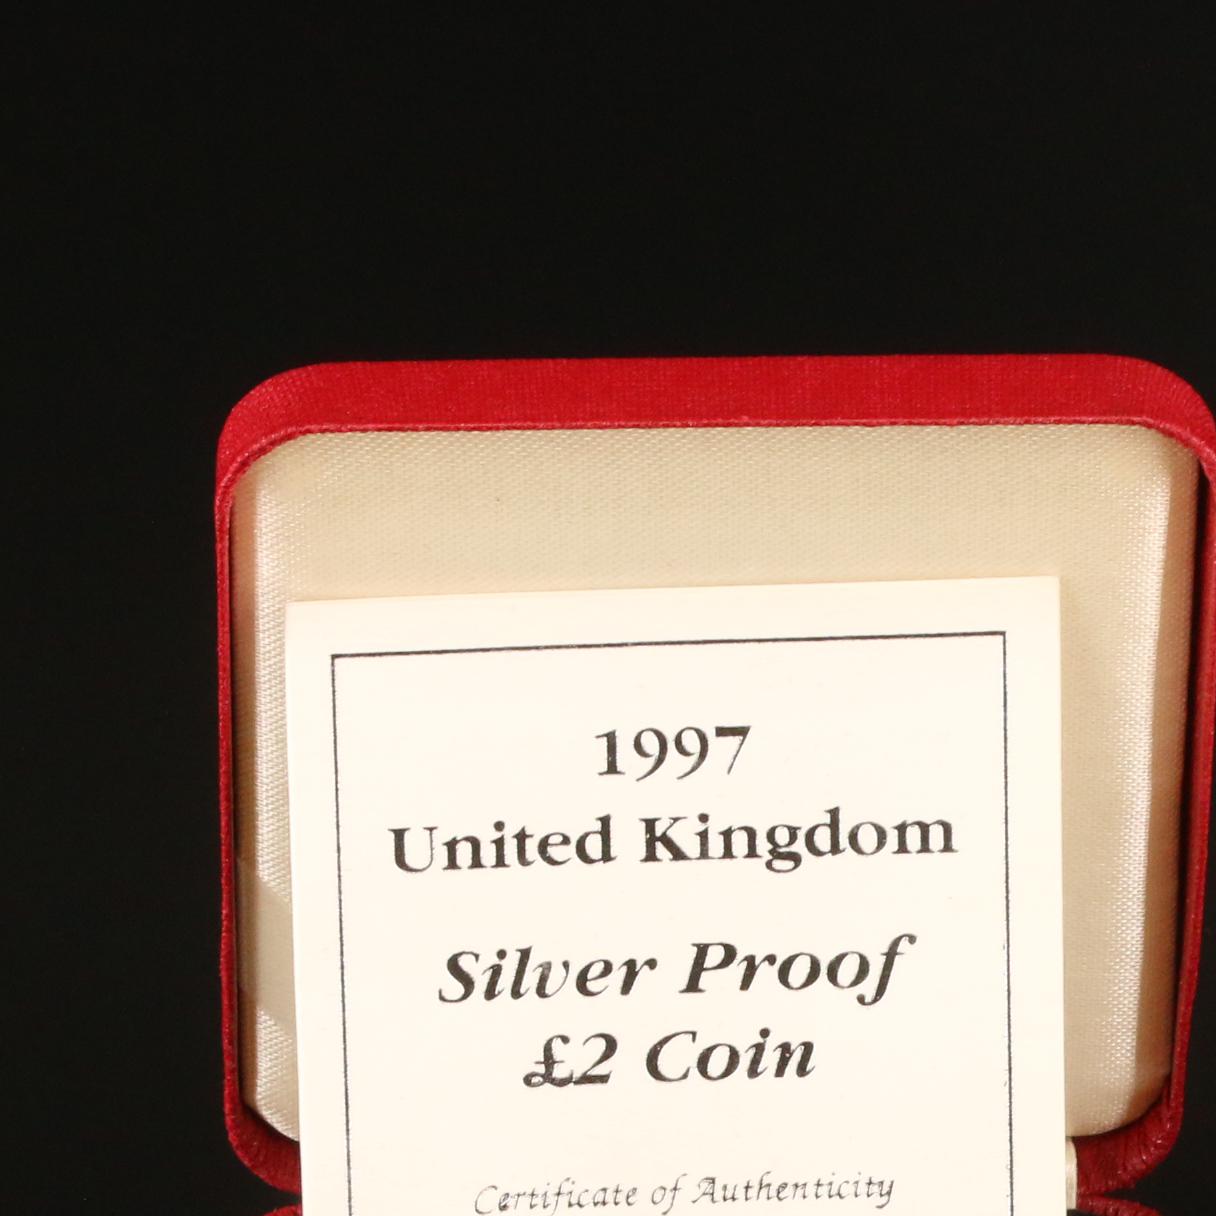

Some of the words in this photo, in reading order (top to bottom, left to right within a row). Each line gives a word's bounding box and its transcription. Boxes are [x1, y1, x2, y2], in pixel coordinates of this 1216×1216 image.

[595, 726, 751, 781] 1997
[388, 814, 617, 873] United
[639, 806, 958, 873] Kingdom
[439, 946, 657, 1003] Silver
[679, 934, 917, 1006] Proof
[523, 1033, 617, 1088] £2
[646, 1027, 815, 1082] Coin
[651, 1173, 686, 1216] of
[691, 1171, 894, 1209] Authenticity
